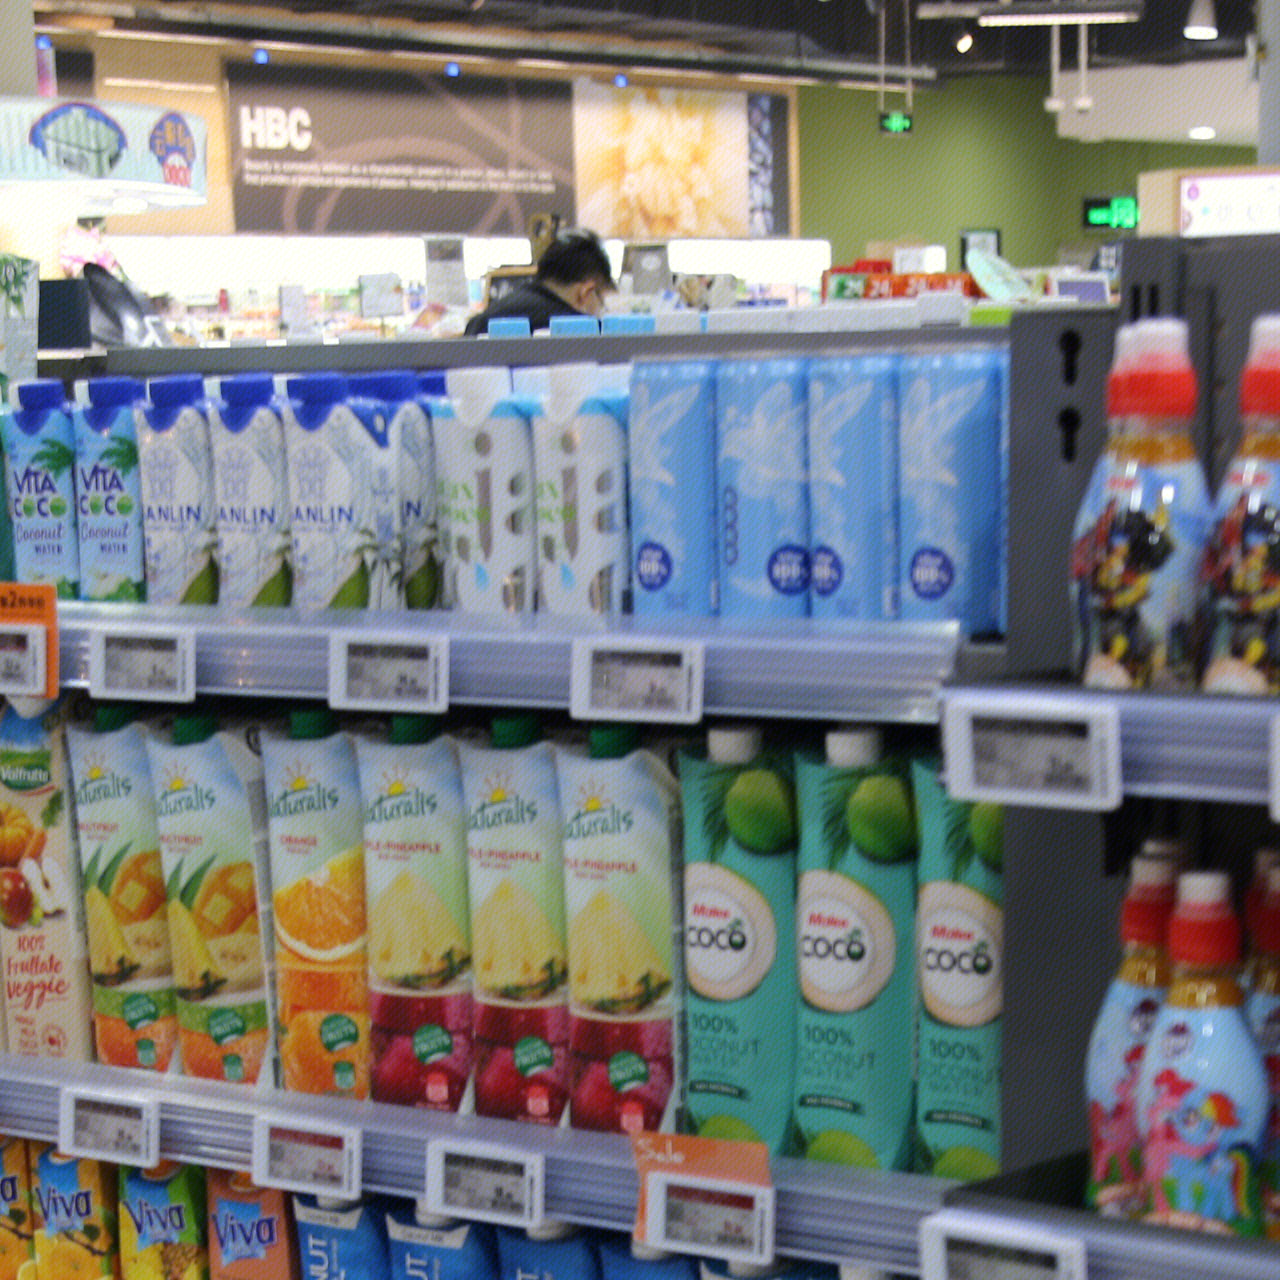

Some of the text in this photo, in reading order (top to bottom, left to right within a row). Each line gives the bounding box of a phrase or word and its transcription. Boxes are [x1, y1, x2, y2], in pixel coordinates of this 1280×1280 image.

[239, 104, 313, 151] HBC
[13, 467, 58, 495] VITA
[80, 465, 125, 493] VITA
[14, 495, 68, 518] COCO
[79, 493, 134, 518] COCO
[146, 505, 202, 524] ANLIN
[220, 505, 276, 525] ANLIN
[76, 774, 133, 806] aturalis
[157, 785, 216, 816] aturalis
[270, 785, 340, 818] aturalis
[365, 790, 439, 824] aturalis
[34, 1185, 94, 1222] Viva
[124, 1198, 187, 1235] Viva
[211, 1212, 280, 1249] Viva
